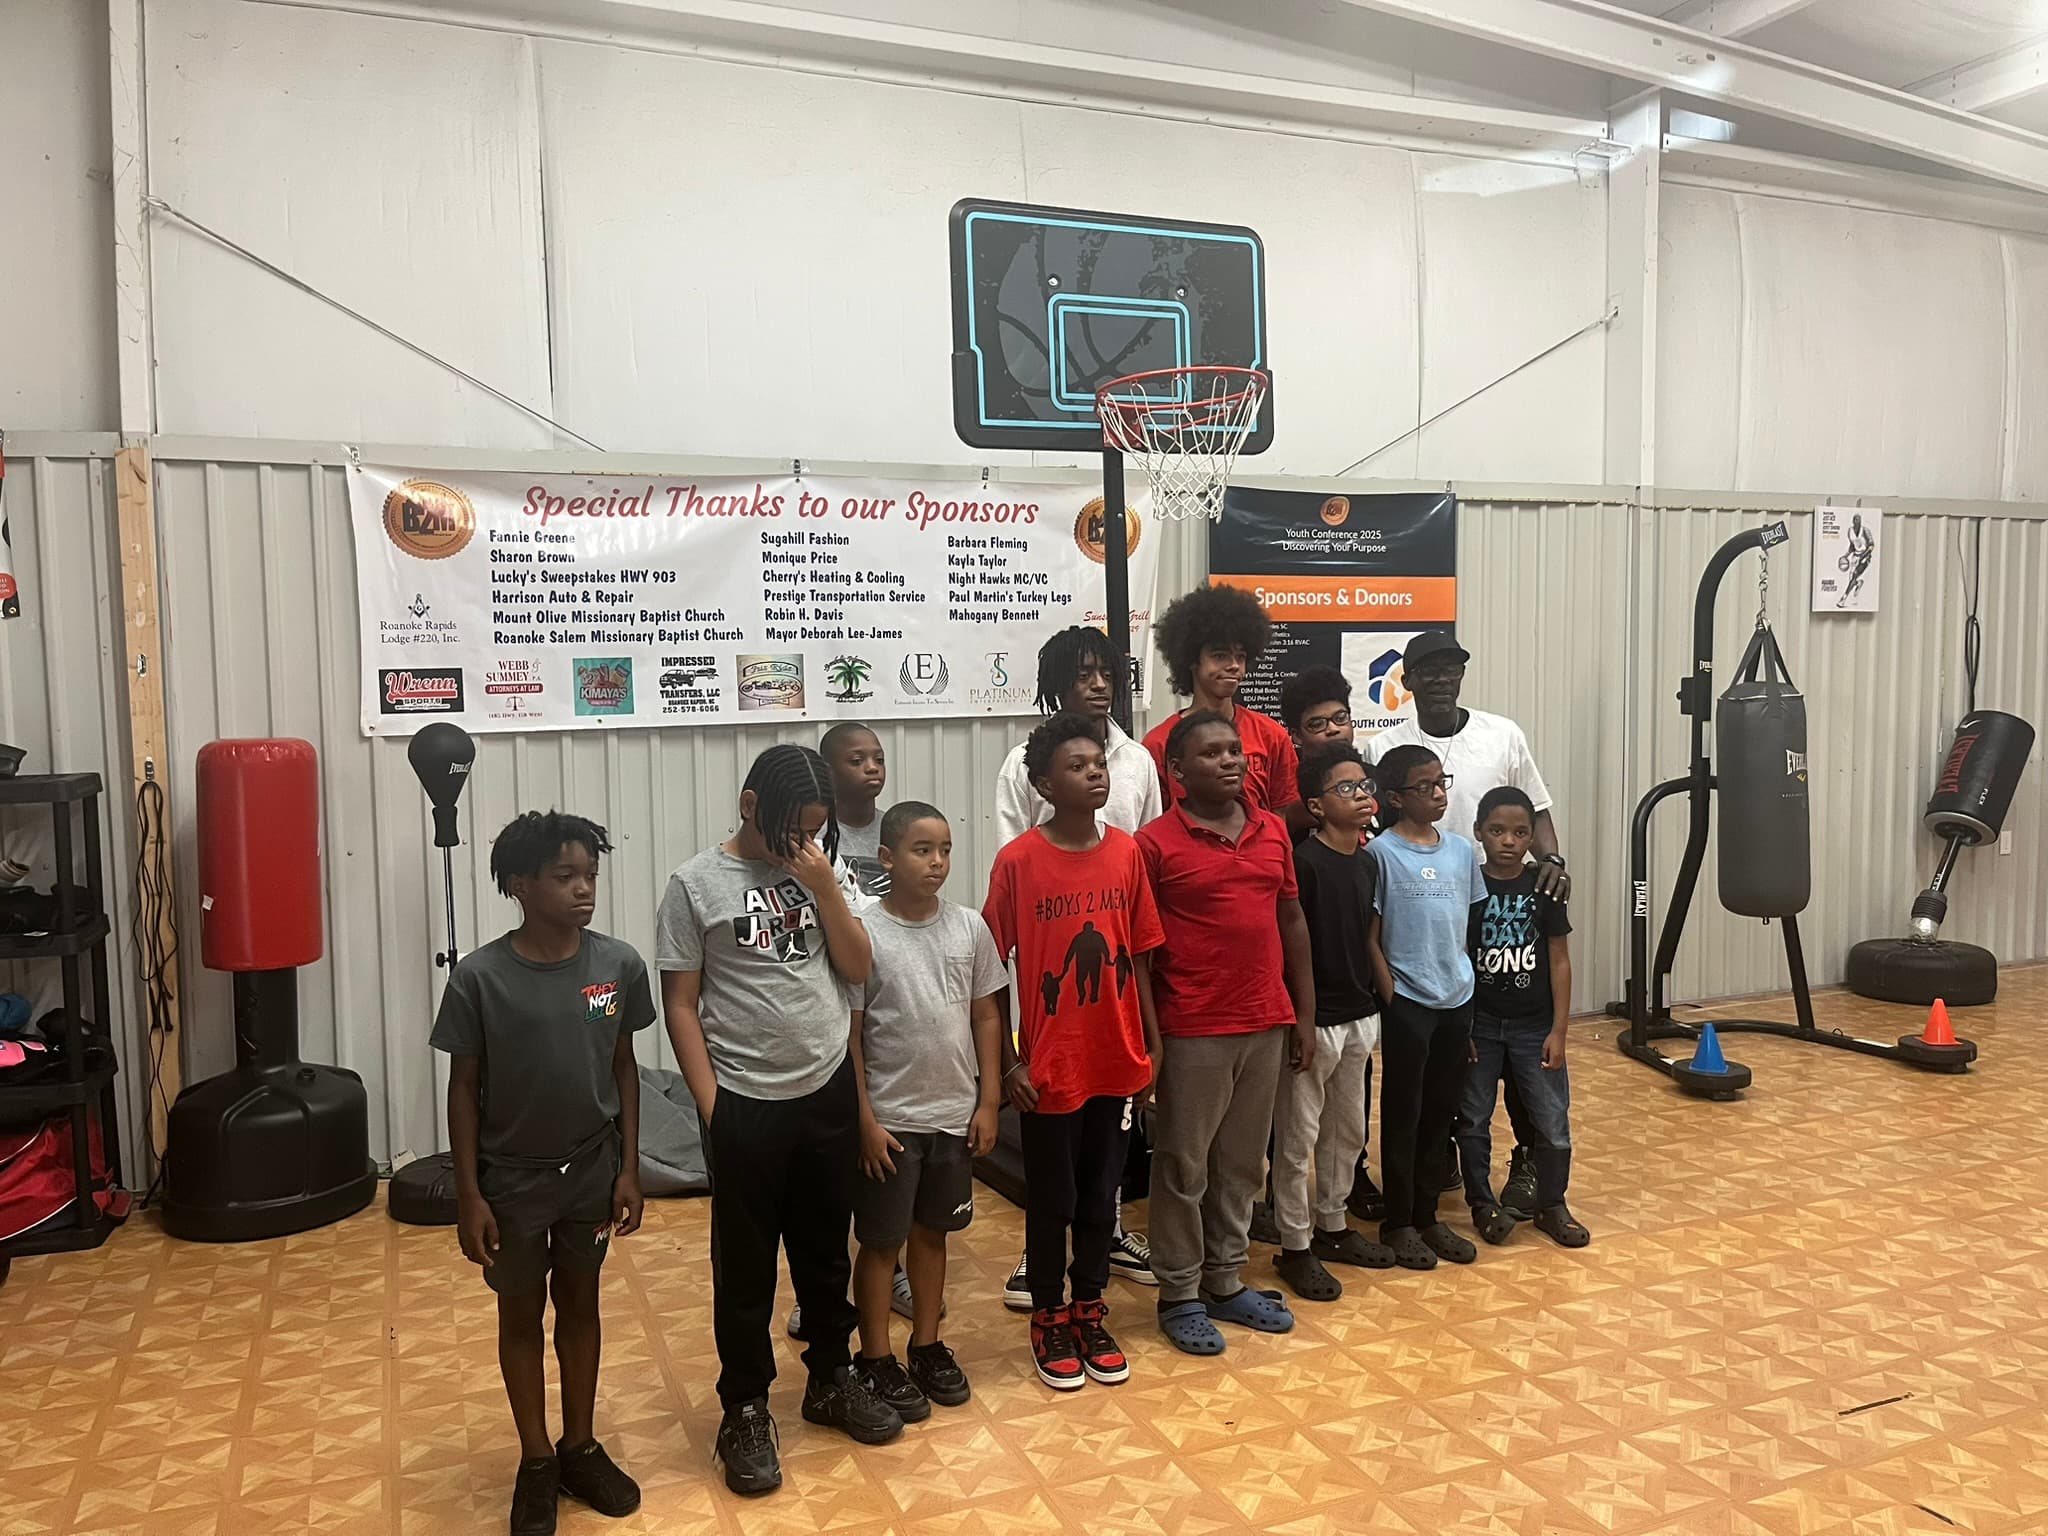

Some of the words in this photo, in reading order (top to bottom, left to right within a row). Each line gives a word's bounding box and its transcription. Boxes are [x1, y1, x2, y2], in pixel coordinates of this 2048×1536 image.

[523, 485, 651, 526] Special
[666, 483, 786, 518] Thanks
[799, 491, 829, 518] to
[841, 498, 896, 521] our
[906, 490, 1039, 531] Sponsors
[490, 530, 529, 542] Fannie
[535, 531, 575, 543] Greene
[761, 532, 804, 547] Sugahill
[809, 532, 849, 545] Fashion
[1286, 528, 1310, 539] Youth
[1311, 529, 1358, 540] Conference
[1360, 530, 1382, 540] 2025
[948, 536, 986, 548] Barbara
[991, 536, 1027, 552] Fleming
[1283, 541, 1330, 553] Discovering
[1331, 542, 1351, 552] Your
[1352, 543, 1386, 554] Purpose
[490, 549, 532, 562] Sharon
[538, 551, 574, 562] Brown
[762, 551, 806, 566] Monique
[811, 552, 837, 563] Price
[949, 554, 974, 569] Kayla
[978, 555, 1006, 569] Taylor
[492, 570, 536, 586] Lucky's
[541, 570, 615, 586] Sweepstakes
[621, 570, 648, 583] HWY
[653, 571, 675, 583] 903
[763, 570, 805, 586] Cherry's
[810, 570, 851, 586] Heating
[855, 572, 863, 582] &
[867, 571, 904, 587] Cooling
[949, 572, 975, 587] Night
[980, 572, 1010, 584] Hawks
[1014, 573, 1048, 585] MC/VC
[493, 590, 544, 603] Harrison
[549, 591, 576, 603] Auto
[582, 591, 590, 603] &
[596, 590, 633, 606] Repair
[764, 589, 805, 604] Prestige
[810, 589, 884, 605] Transportation
[889, 590, 925, 602] Service
[950, 590, 969, 602] Paul
[974, 591, 1013, 602] Martin's
[1016, 591, 1047, 605] Turkey
[1052, 591, 1071, 605] Legs
[1254, 587, 1332, 608] Sponsors
[1336, 588, 1349, 606] &
[1355, 587, 1413, 606] Donors
[494, 611, 531, 623] Mount
[536, 610, 566, 623] Olive
[572, 610, 635, 626] Missionary
[640, 610, 680, 625] Baptist
[685, 609, 724, 621] Church
[765, 608, 795, 620] Robin
[799, 608, 809, 620] H.
[815, 608, 843, 620] Davis
[950, 608, 998, 623] Mahogany
[1002, 609, 1038, 620] Bennett
[380, 621, 422, 630] Roanoke
[425, 621, 457, 631] Rapids
[381, 634, 410, 645] Lodge
[414, 634, 439, 644] #220,
[443, 633, 461, 643] Inc.
[494, 630, 544, 644] Roanoke
[550, 630, 585, 643] Salem
[591, 630, 653, 645] Missionary
[659, 629, 699, 645] Baptist
[704, 628, 743, 640] Church
[766, 627, 797, 642] Mayor
[801, 627, 843, 639] Deborah
[848, 627, 902, 638] Lee-James
[498, 660, 529, 671] WEBB
[661, 656, 715, 667] IMPRESSED
[386, 672, 457, 696] Wrenn
[486, 672, 529, 682] SUMMEY
[488, 685, 519, 693] ATTORNEYS
[580, 687, 627, 699] KIMAYA'S
[707, 688, 721, 697] LLC
[970, 688, 1031, 700] PLATINUM
[1351, 719, 1375, 728] OUTH
[744, 880, 806, 916] AIR
[1633, 880, 1649, 917] EVERLAST
[1035, 891, 1082, 923] #BOYS
[1086, 891, 1095, 913] 2
[1483, 894, 1527, 919] ALL
[737, 904, 818, 950] JORDA
[1481, 921, 1531, 947] DAY
[1477, 944, 1536, 974] LONG
[581, 981, 617, 1000] THEY
[589, 990, 618, 1012] NOT
